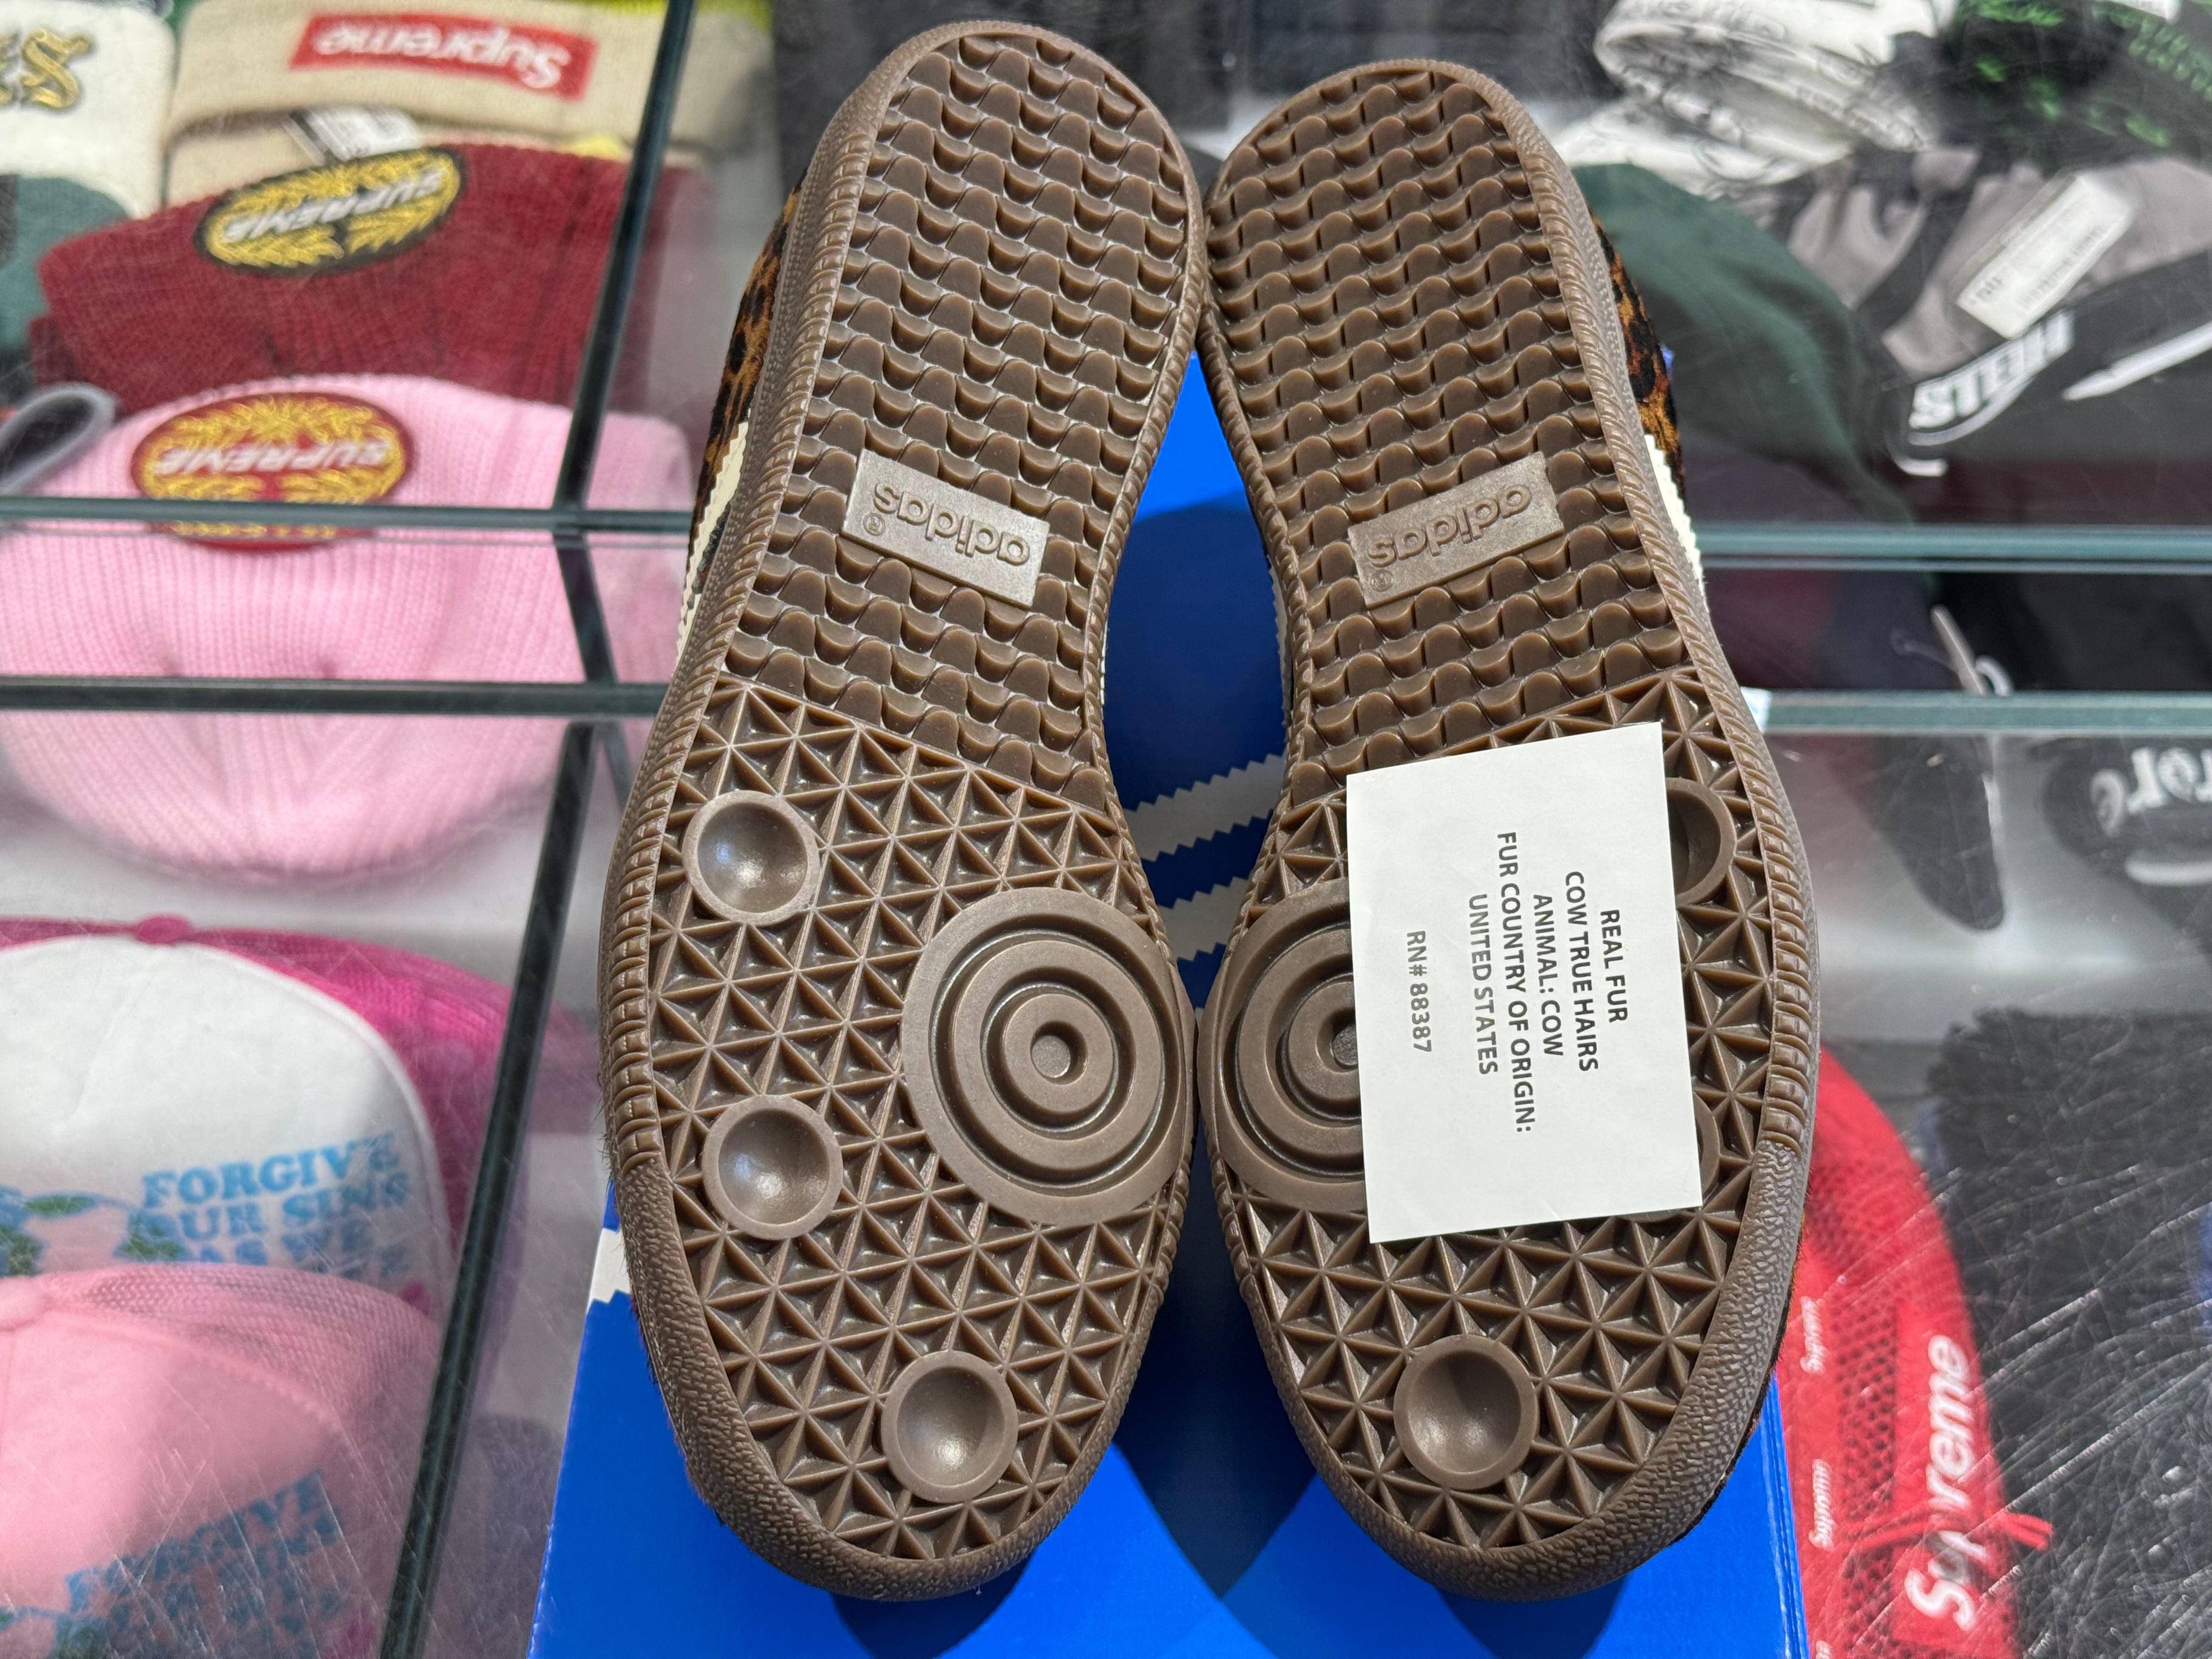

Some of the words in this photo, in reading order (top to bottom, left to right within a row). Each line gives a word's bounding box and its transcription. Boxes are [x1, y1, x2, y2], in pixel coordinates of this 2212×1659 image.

[312, 21, 572, 89] Supreme
[222, 167, 445, 243] SUPREME
[154, 438, 392, 475] SUPREME
[873, 483, 1030, 566] adidas
[1367, 484, 1532, 568] adidas
[1497, 832, 1518, 877] FUR
[1566, 872, 1587, 925] COW
[1407, 931, 1427, 976] RN#
[1469, 894, 1492, 980] UNITED
[1501, 883, 1526, 992] COUNTRY
[1533, 895, 1558, 994] ANIMAL:
[1569, 931, 1592, 993] TRUE
[1600, 910, 1623, 969] REAL
[1410, 983, 1431, 1052] 88387
[1475, 987, 1498, 1074] STATES
[1508, 1001, 1528, 1031] OF
[1542, 1000, 1564, 1056] COW
[1605, 975, 1628, 1023] FUR
[1574, 998, 1598, 1071] HAIRS
[1511, 1039, 1535, 1132] ORIGIN:
[142, 1132, 399, 1208] FORGIVE
